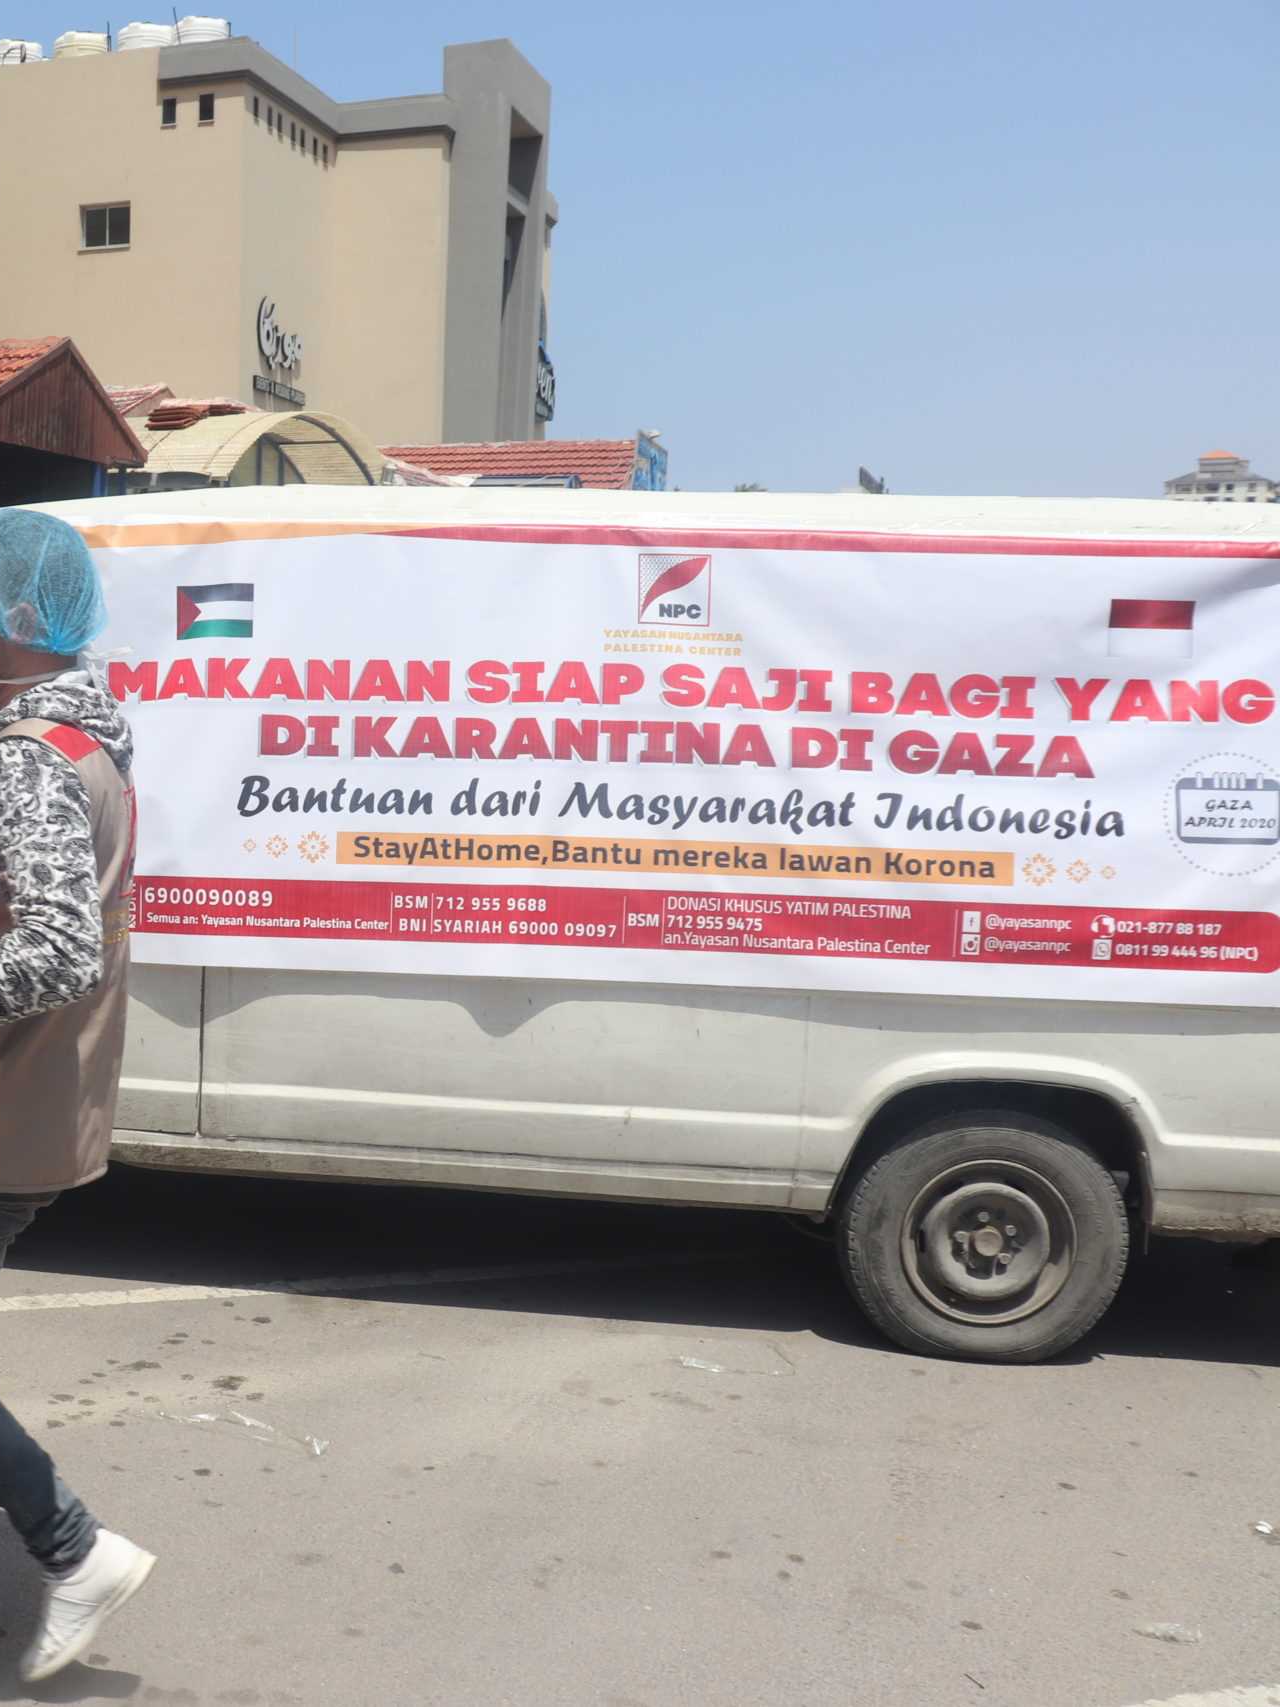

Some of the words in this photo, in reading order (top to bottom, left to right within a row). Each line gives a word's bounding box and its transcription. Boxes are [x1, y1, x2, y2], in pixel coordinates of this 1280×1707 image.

[659, 603, 702, 619] NPC
[603, 629, 666, 639] YAYASAN
[668, 631, 743, 642] NUSANTARA
[603, 643, 683, 655] PALESTINA
[688, 646, 742, 657] CENTER
[108, 657, 450, 702] MAKANAN
[467, 660, 645, 704] SIAP
[662, 663, 832, 712] SAJI
[851, 671, 1035, 719] BAGI
[1056, 677, 1275, 724] YANG
[260, 714, 340, 757] DI
[354, 716, 775, 767] KARANTINA
[791, 727, 873, 771] DI
[888, 730, 1096, 778] GAZA
[237, 775, 433, 818] Bantuan
[450, 778, 542, 817] dari
[558, 781, 857, 833] Masyarakat
[873, 791, 1126, 840] Indonesia
[1205, 799, 1253, 812] GAZA
[1184, 816, 1235, 829] APRIL
[1239, 817, 1277, 829] 2020
[353, 835, 641, 866] StayAtHome,Bantu
[653, 848, 767, 871] mereka
[780, 848, 871, 874] lawan
[884, 852, 996, 879] Korona
[144, 887, 273, 908] 6900090089
[394, 894, 428, 909] BSM
[436, 896, 465, 910] 712
[471, 896, 501, 911] 955
[506, 897, 547, 912] 9688
[668, 897, 720, 911] DONASI
[725, 899, 782, 914] KHUSUS
[786, 902, 829, 916] YATIM
[833, 904, 911, 919] PALESTINA
[146, 912, 181, 924] Semua
[183, 914, 199, 926] an:
[201, 914, 243, 929] Yayasan
[246, 916, 300, 929] Nusantara
[303, 917, 352, 930] Palestina
[354, 918, 389, 931] Center
[399, 918, 427, 932] BNI
[433, 919, 503, 934] SYARIAH
[509, 920, 558, 936] 69000
[564, 923, 617, 938] 09097
[628, 913, 659, 928] BSM
[667, 915, 693, 929] 712
[697, 917, 723, 930] 955
[727, 917, 763, 931] 9475
[985, 913, 1072, 930] @yayasannpc
[1117, 920, 1173, 934] 021-877
[1176, 922, 1194, 935] 88
[1197, 922, 1222, 936] 187
[664, 932, 739, 948] an.Yayasan
[743, 935, 814, 951] Nusantara
[818, 937, 882, 953] Palestina
[885, 940, 930, 955] Center
[984, 937, 1072, 953] @yayasannpc
[1116, 943, 1148, 956] 0811
[1151, 944, 1169, 957] 99
[1172, 945, 1197, 958] 444
[1199, 945, 1217, 958] 96
[1220, 946, 1258, 961] (NPC)
